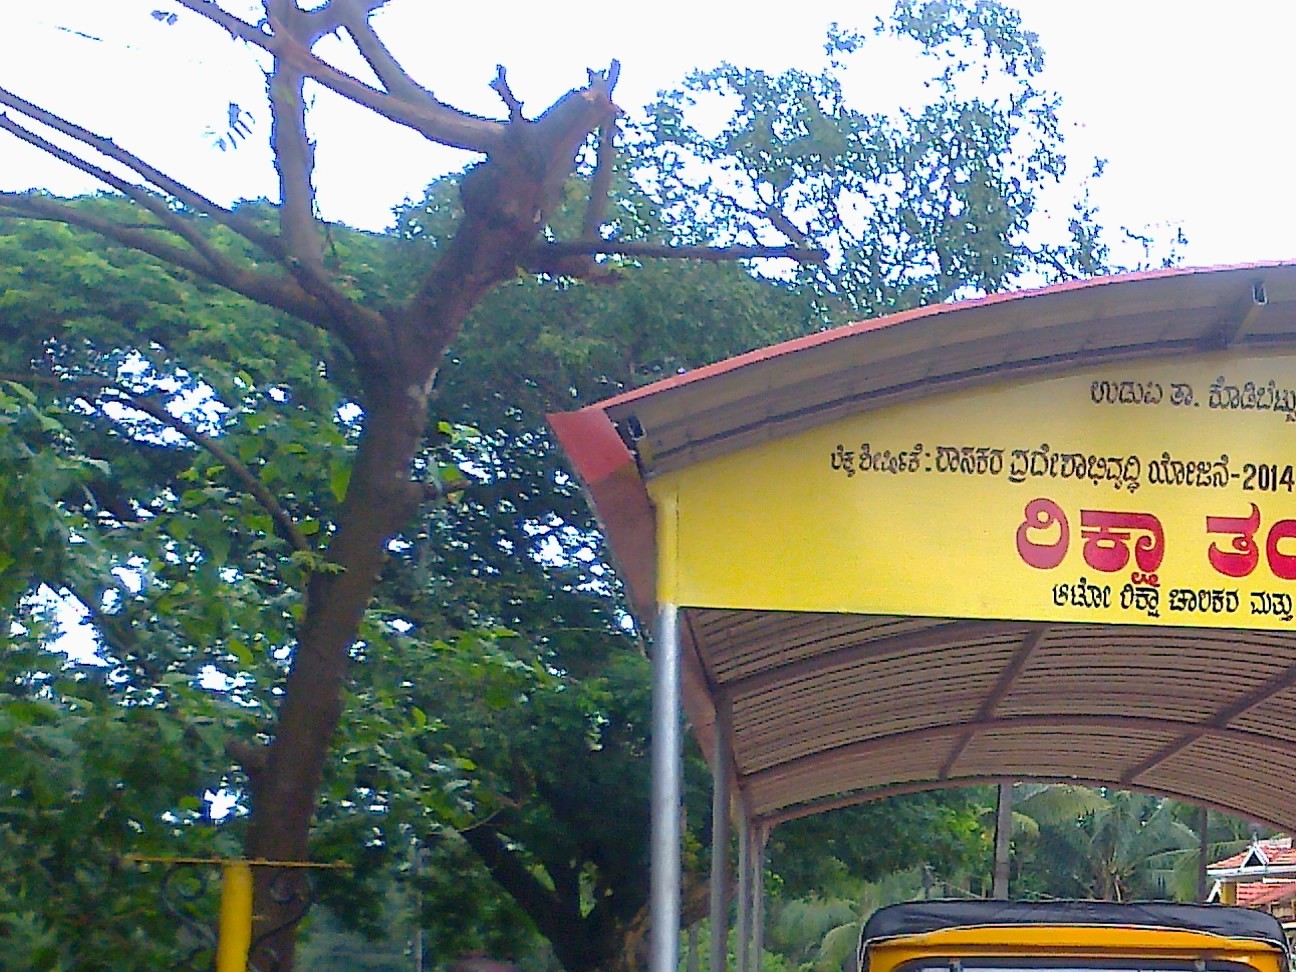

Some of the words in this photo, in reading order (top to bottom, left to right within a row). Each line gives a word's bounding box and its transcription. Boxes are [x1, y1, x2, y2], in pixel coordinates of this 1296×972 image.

[935, 446, 1006, 477] ಶಾಸಕರ
[1016, 498, 1165, 586] ರಿಕ್ಷಾ
[1250, 591, 1294, 621] ಮತ್ತು
